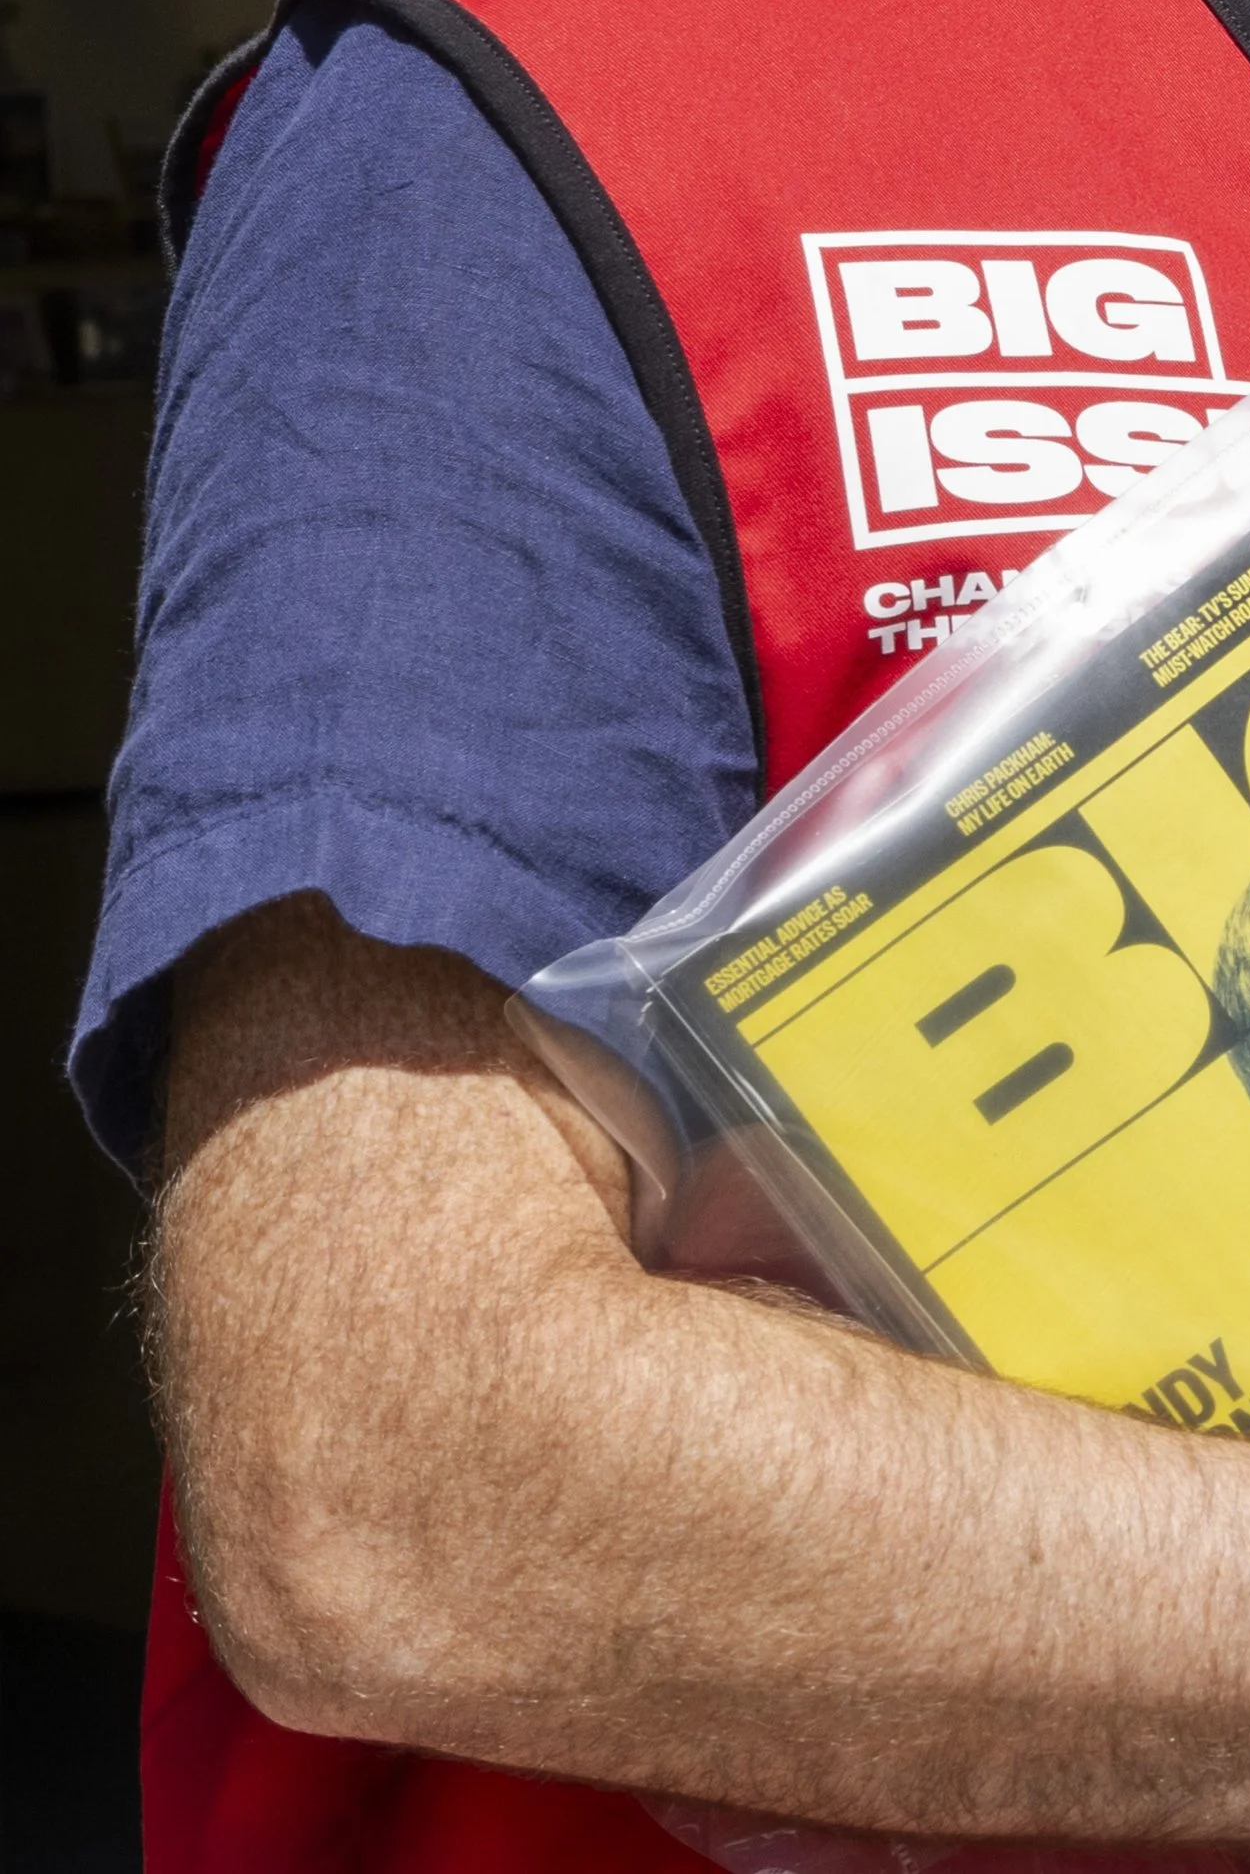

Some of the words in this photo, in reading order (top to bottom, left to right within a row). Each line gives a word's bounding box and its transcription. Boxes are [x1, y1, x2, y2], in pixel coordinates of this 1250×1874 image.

[838, 257, 1196, 364] BIG
[867, 400, 1230, 513] ISS
[868, 614, 974, 656] TH
[1139, 640, 1170, 668] THE
[1164, 616, 1205, 654] BEAR:
[1152, 617, 1236, 688] MUST-WATCH
[945, 780, 989, 818] CHRIS
[983, 732, 1056, 789] PACKHAM:
[957, 809, 984, 836] MY
[979, 789, 1013, 820] LIFE
[1006, 774, 1032, 799] ON
[1025, 742, 1075, 786] EARTH
[704, 937, 781, 996] ESSENTIAL
[776, 899, 828, 945] ADVICE
[823, 885, 847, 910] AS
[717, 951, 796, 1013] MORTGAGE
[789, 920, 837, 961] RATES
[832, 893, 873, 929] SOAR
